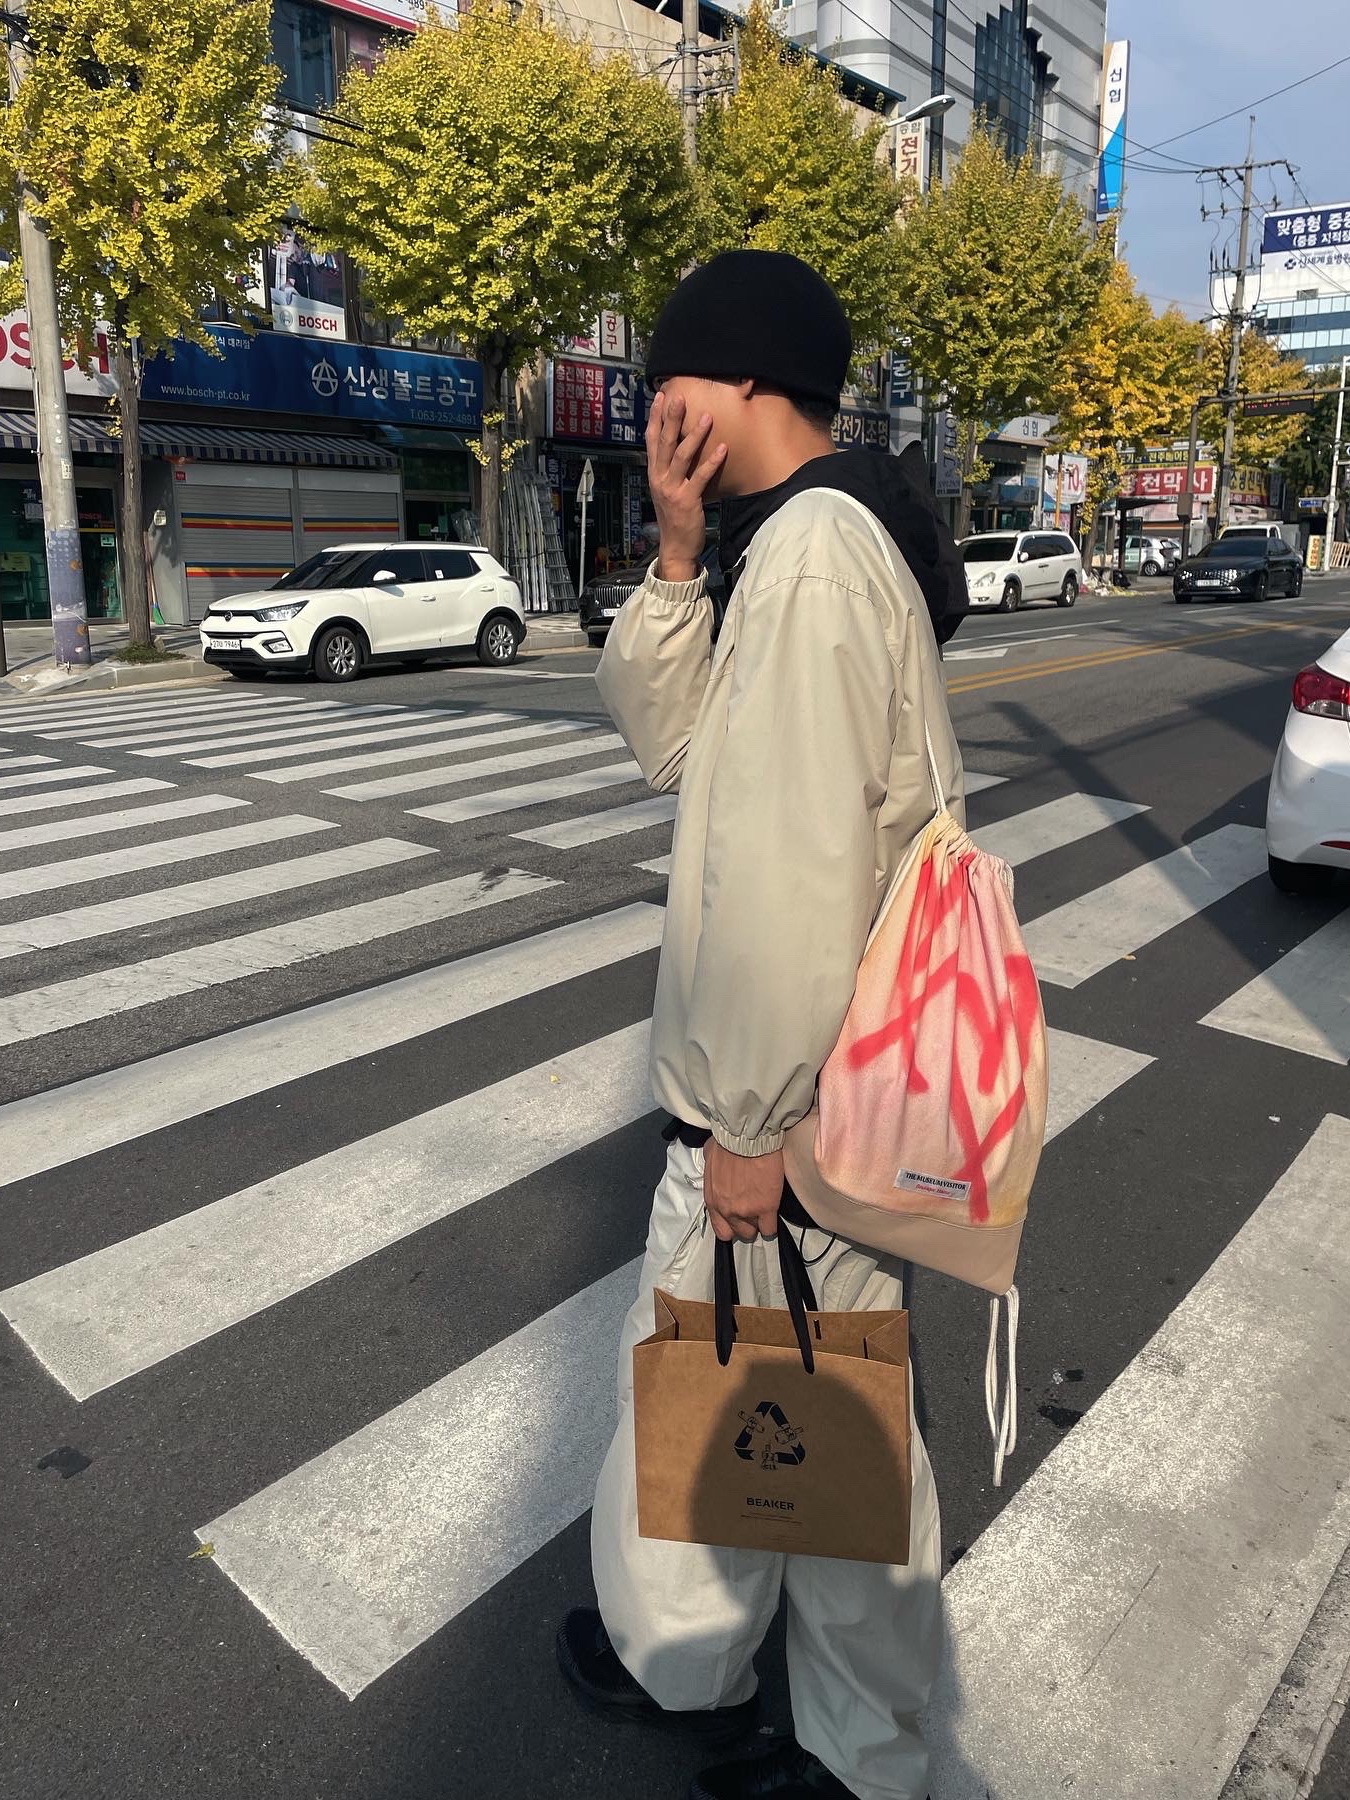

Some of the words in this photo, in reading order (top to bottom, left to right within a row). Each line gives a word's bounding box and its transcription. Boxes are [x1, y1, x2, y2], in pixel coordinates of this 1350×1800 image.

[1108, 67, 1122, 103] 신협
[1277, 215, 1321, 237] 맞춤형
[298, 314, 338, 332] BOSCH
[606, 315, 617, 350] 공구
[343, 366, 477, 408] 신생볼트공구
[1022, 419, 1039, 437] 신협
[746, 1497, 795, 1511] BEAKER
